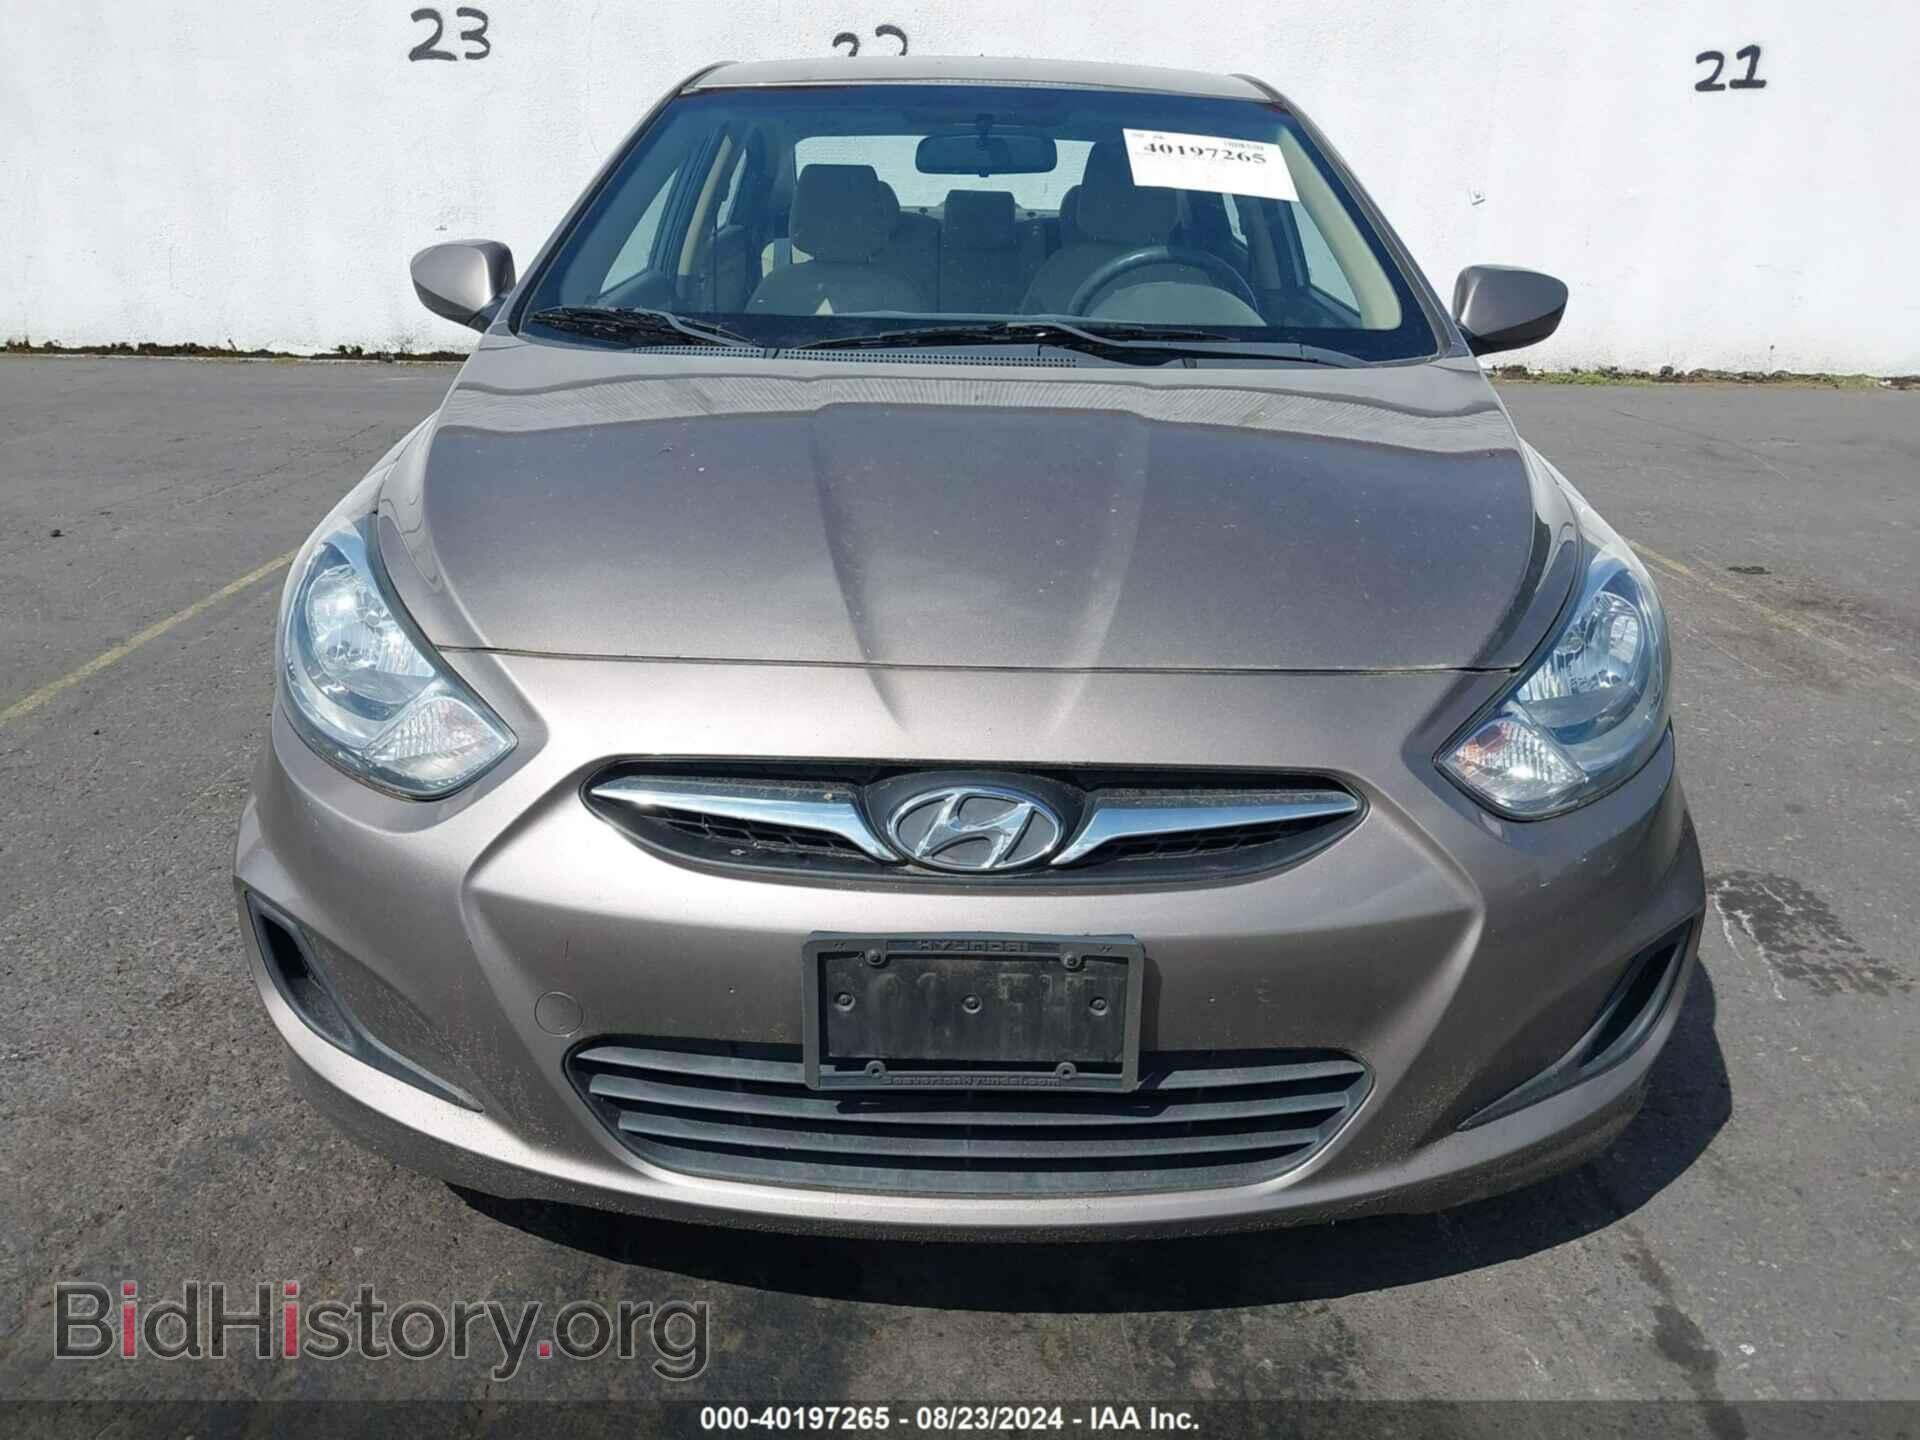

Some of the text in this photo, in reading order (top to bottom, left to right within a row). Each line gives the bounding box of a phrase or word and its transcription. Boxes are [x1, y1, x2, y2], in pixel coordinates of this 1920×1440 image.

[408, 7, 491, 61] 23
[1694, 44, 1767, 92] 21
[1144, 142, 1267, 165] 40197265
